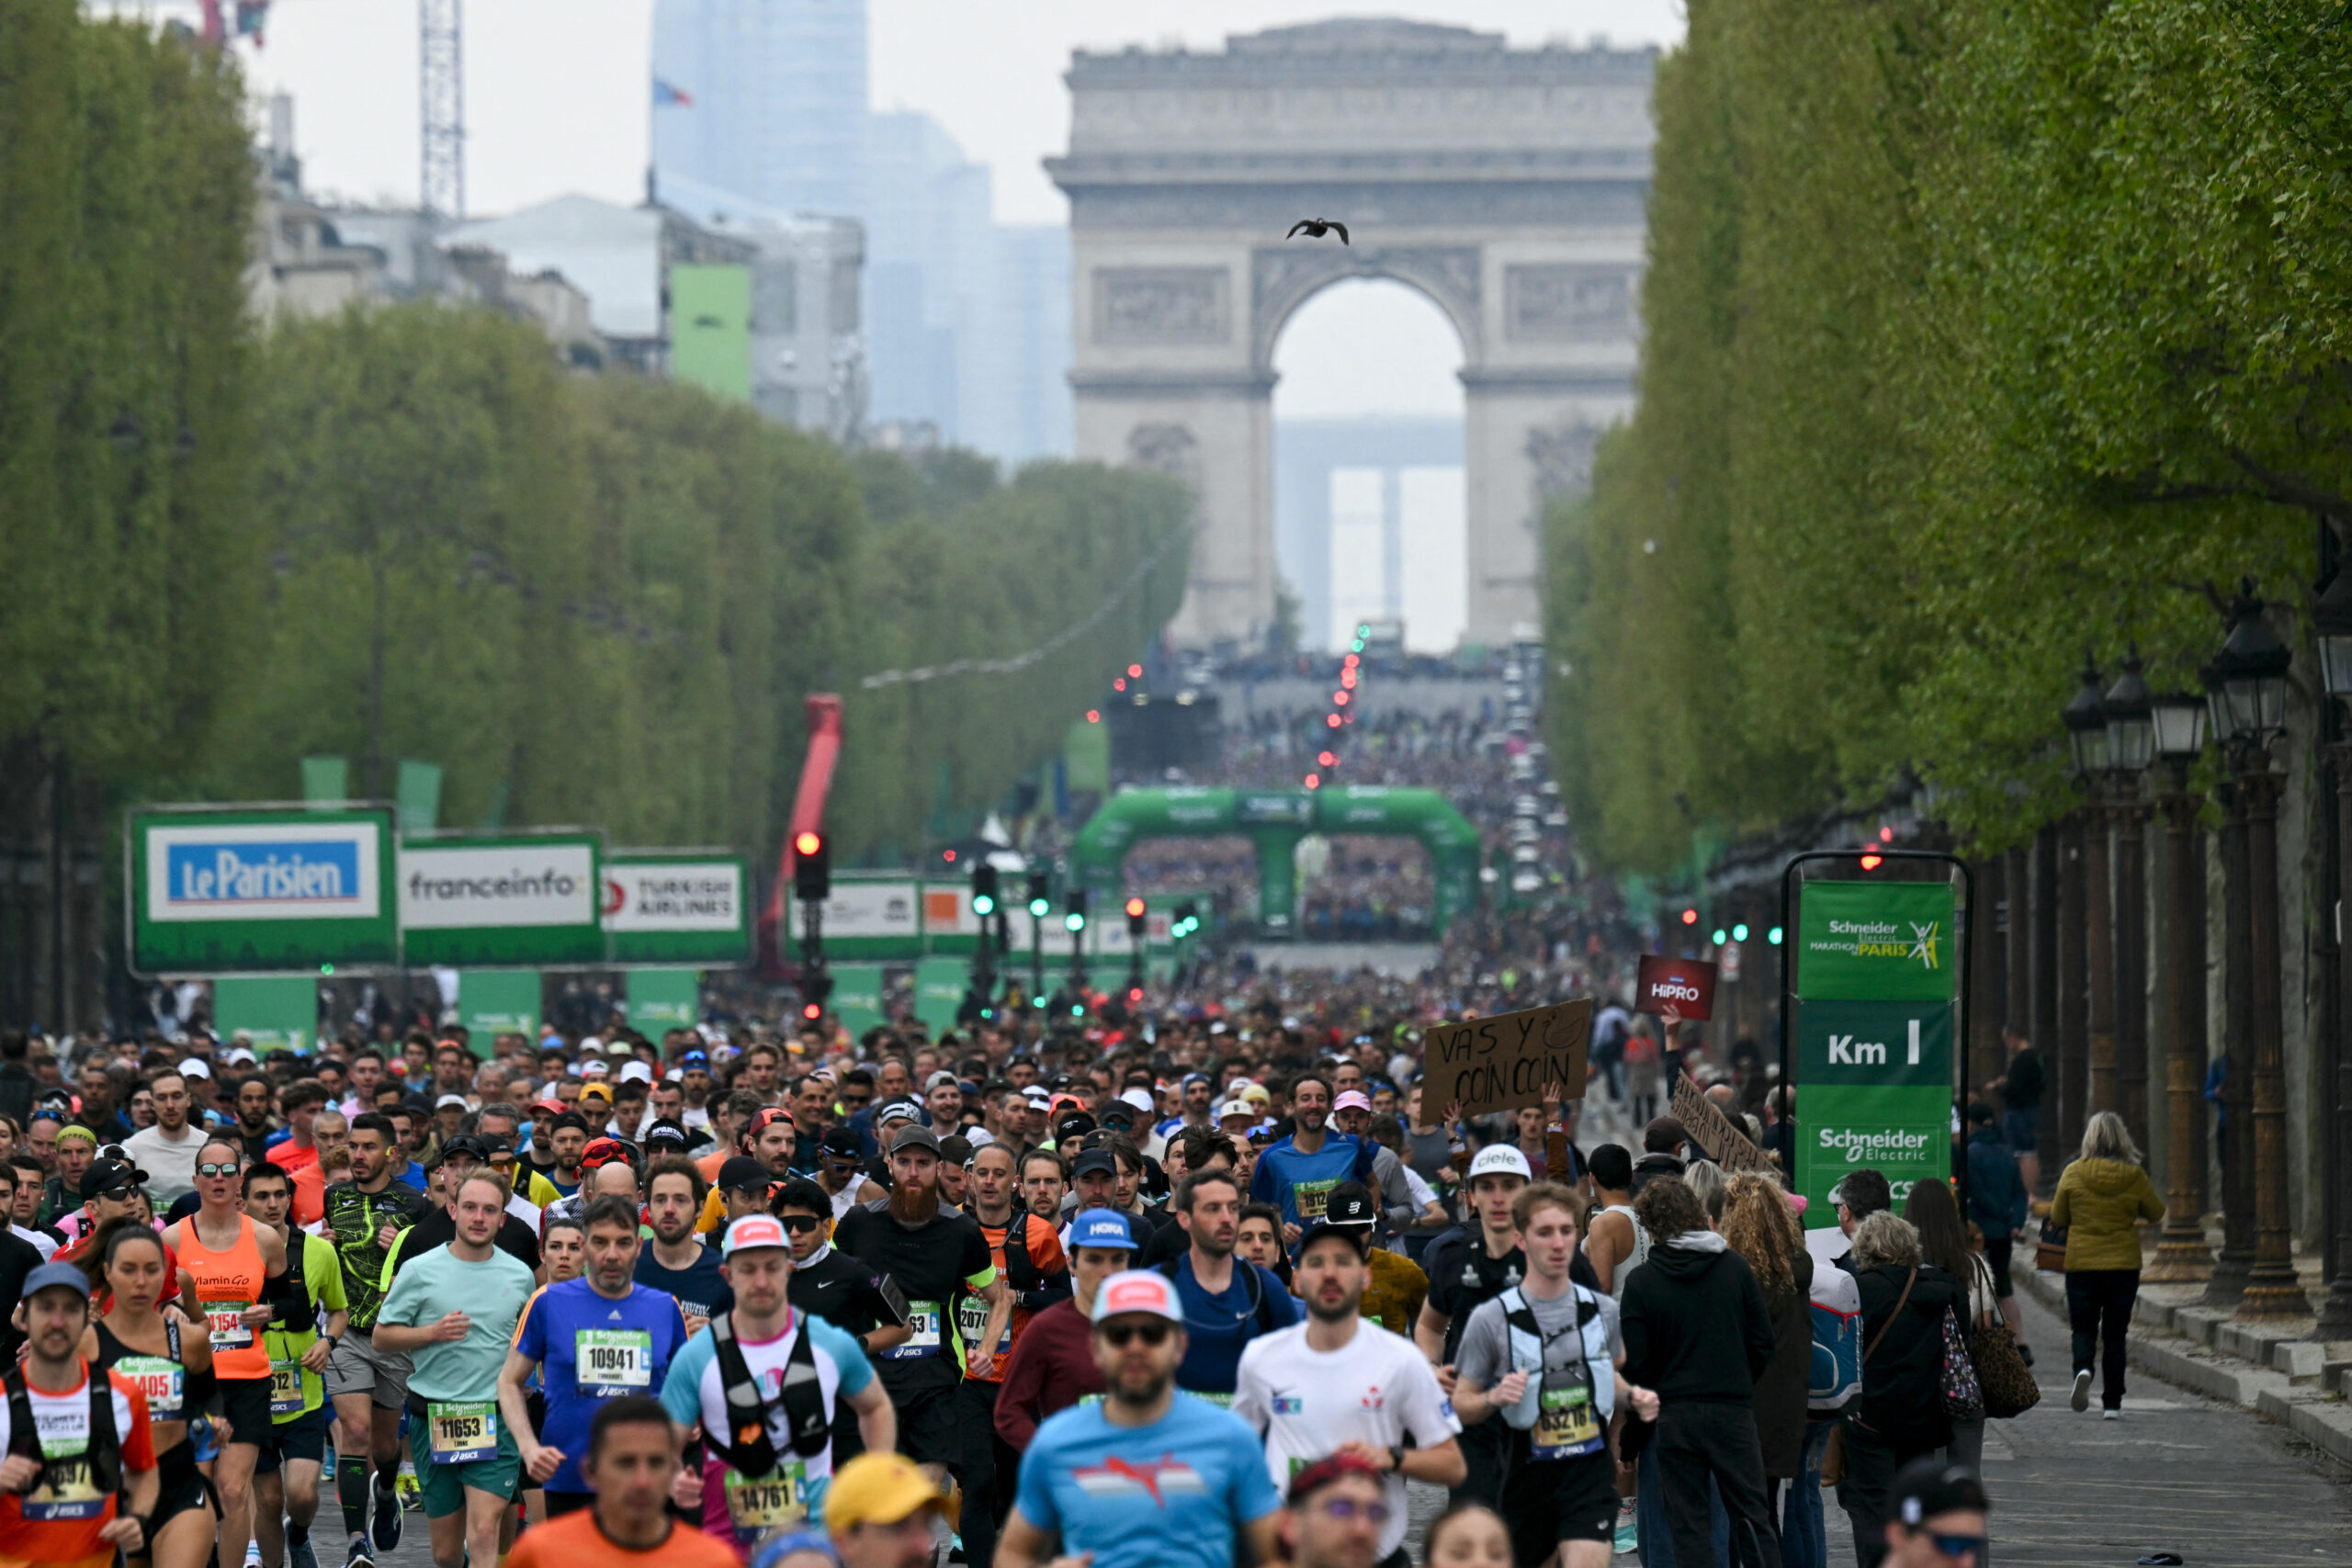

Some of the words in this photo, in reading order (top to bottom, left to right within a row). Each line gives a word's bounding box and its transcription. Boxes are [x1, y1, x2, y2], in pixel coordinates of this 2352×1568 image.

[184, 860, 214, 899] Le
[217, 848, 341, 898] Parisien
[1829, 921, 1898, 933] Schneider
[1810, 942, 1860, 952] MARATHON
[1859, 943, 1907, 956] PARIS
[1651, 983, 1699, 1002] HiPRO
[1438, 1023, 1498, 1064] VAS
[1517, 1017, 1534, 1053] Y
[1828, 1035, 1886, 1065] Km
[1907, 1020, 1920, 1065] 1
[1819, 1129, 1928, 1148] Schneider
[1477, 1152, 1517, 1168] ciele
[1866, 1149, 1926, 1160] Electric
[1090, 1222, 1124, 1236] HOKA
[589, 1348, 633, 1371] 10941
[903, 1348, 922, 1357] asics
[607, 1388, 629, 1396] asics
[446, 1403, 486, 1412] Schneider
[440, 1418, 481, 1438] 11653
[459, 1451, 478, 1461] asics
[741, 1484, 789, 1513] 14761
